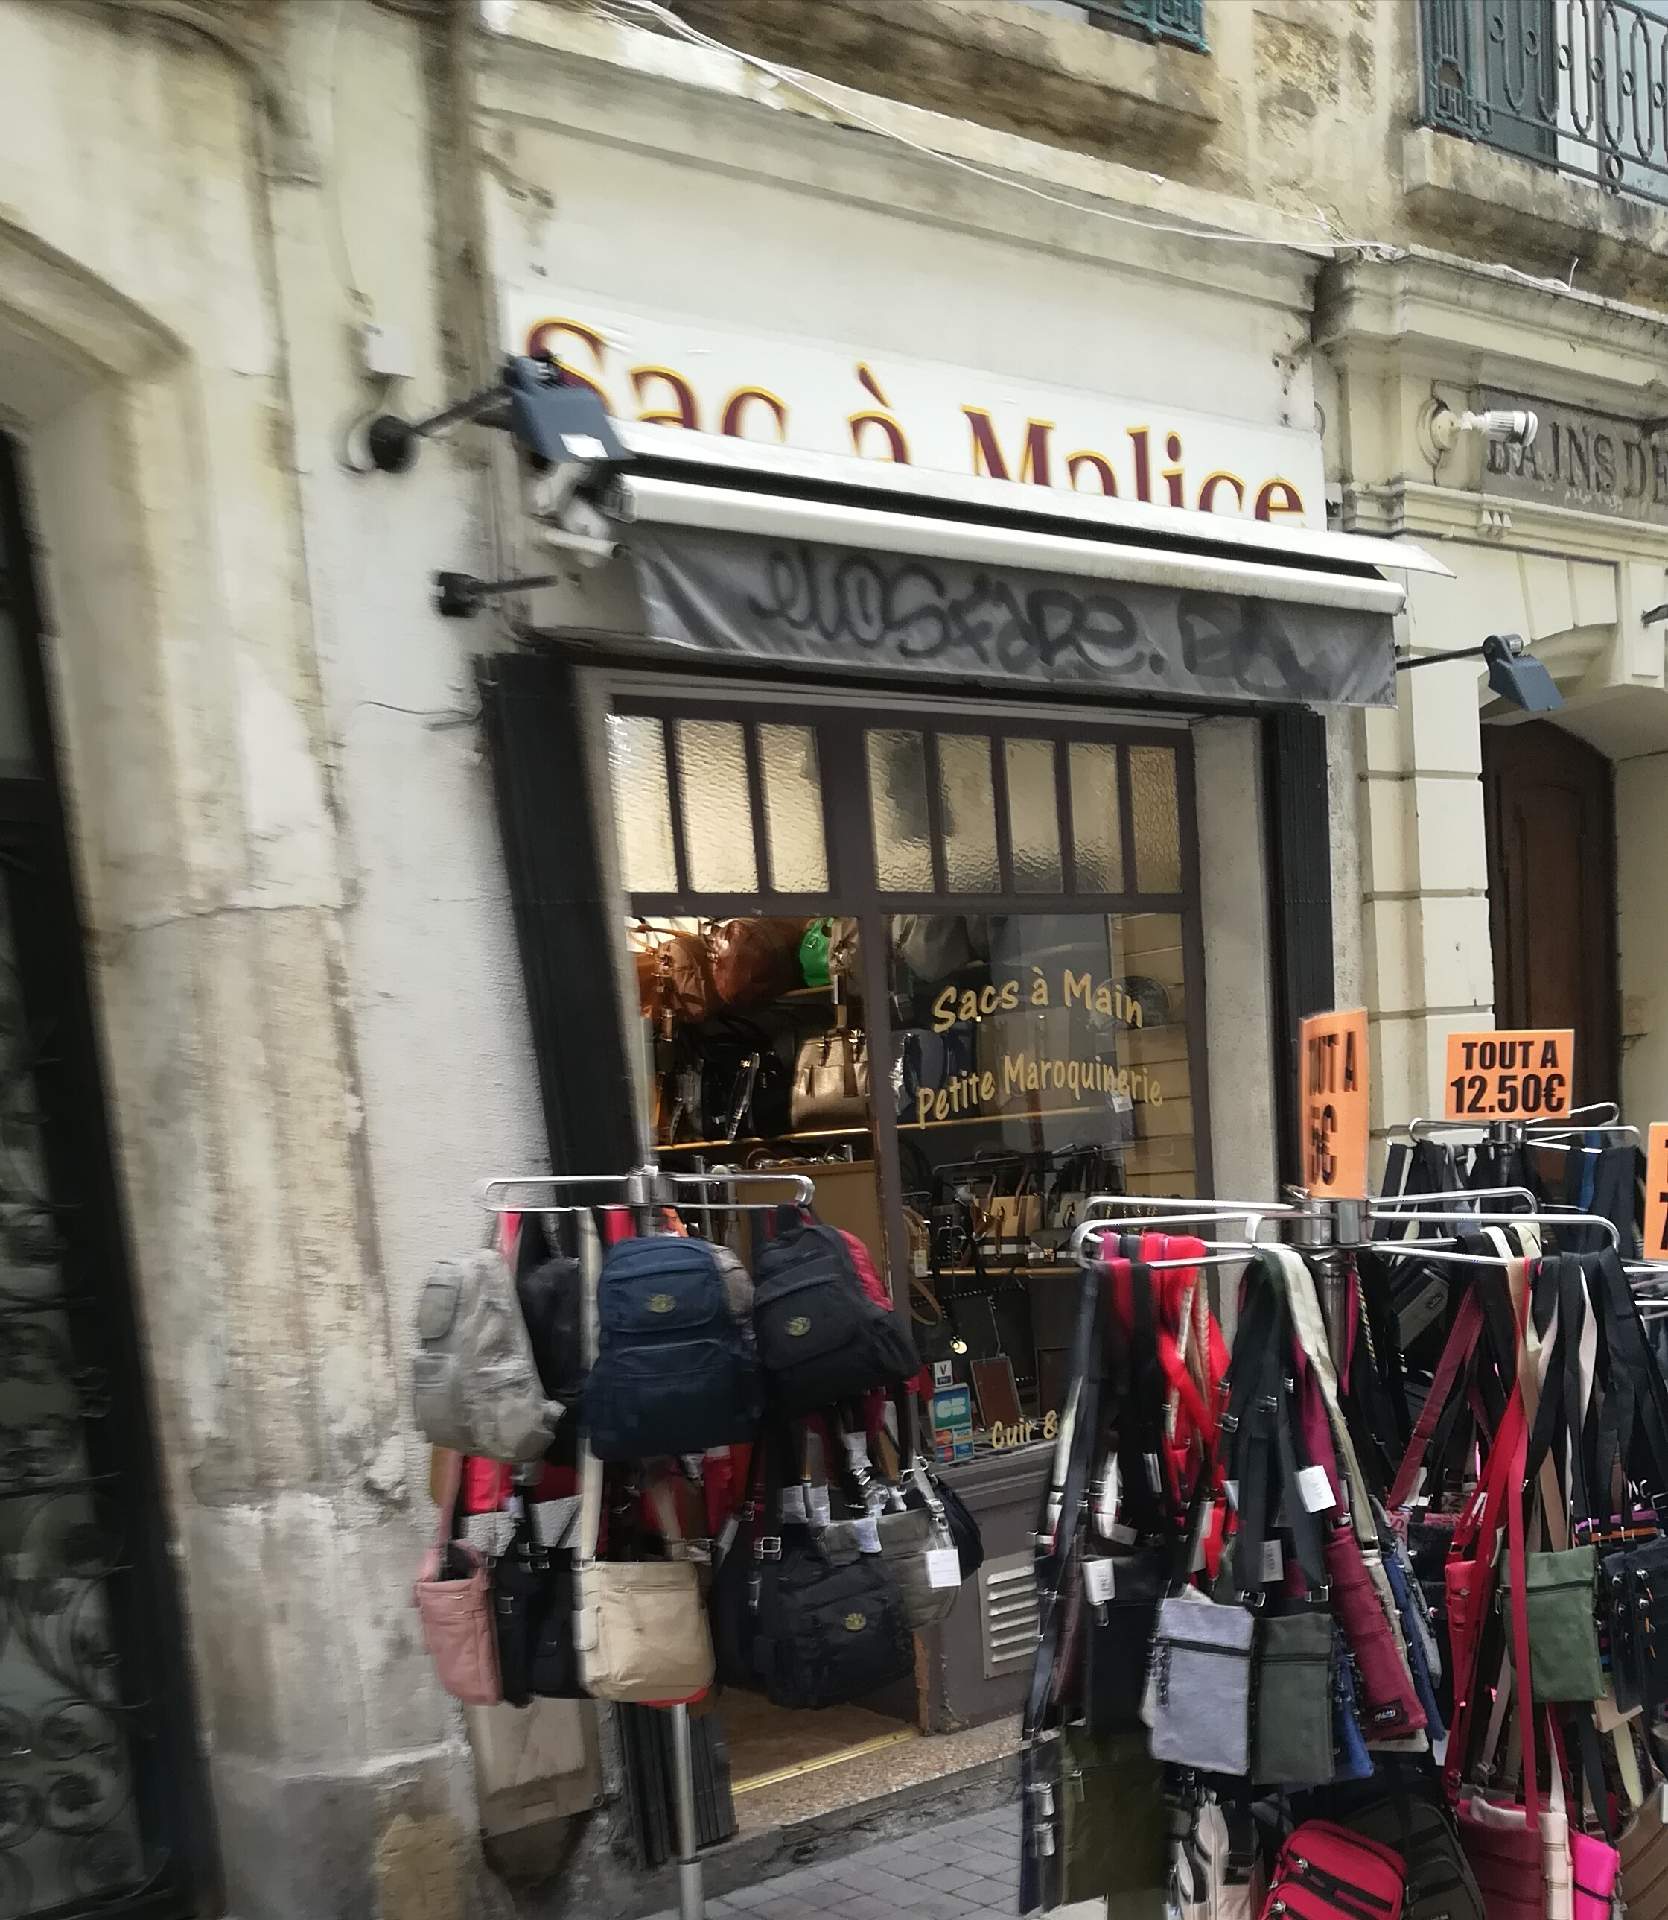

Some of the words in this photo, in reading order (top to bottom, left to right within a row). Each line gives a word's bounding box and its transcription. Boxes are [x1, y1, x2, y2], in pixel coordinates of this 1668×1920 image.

[933, 978, 1020, 1034] Sacs
[1032, 966, 1050, 1007] à
[1064, 968, 1144, 1029] Main
[1462, 1040, 1534, 1071] TOUT
[1540, 1039, 1559, 1069] A
[916, 1070, 996, 1130] Petite
[1004, 1053, 1164, 1108] Maroquinerie
[1450, 1073, 1567, 1115] 12.50€
[992, 1421, 1034, 1449] Cuir
